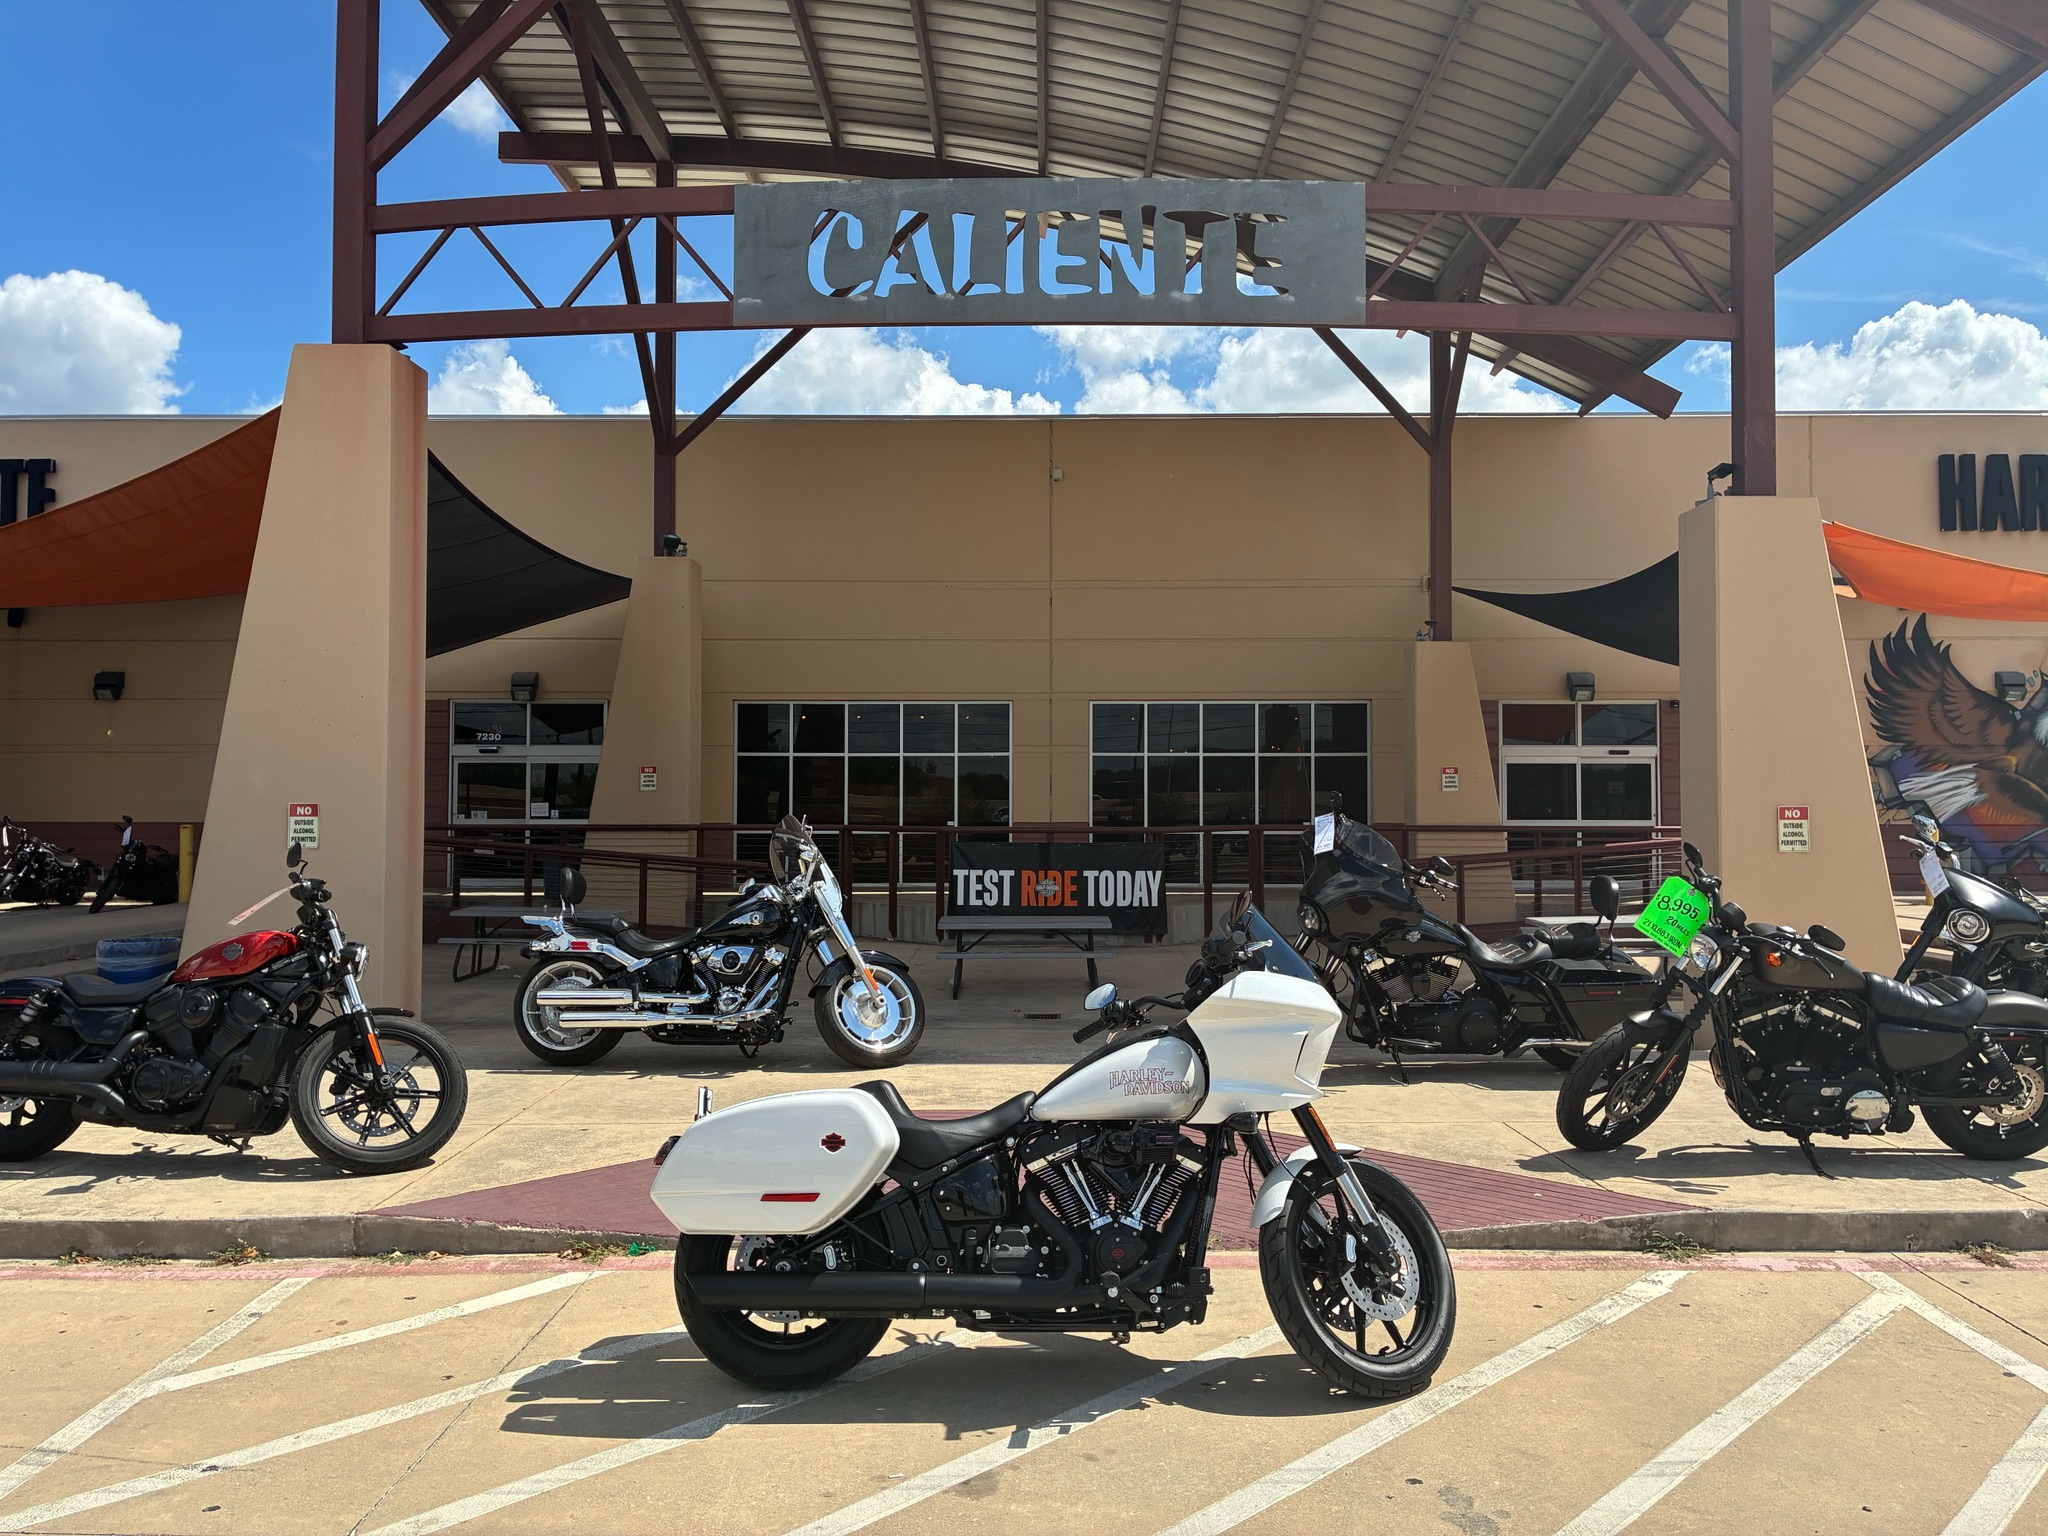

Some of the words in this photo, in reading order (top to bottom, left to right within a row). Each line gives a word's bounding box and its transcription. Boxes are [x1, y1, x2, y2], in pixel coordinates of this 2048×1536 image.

[807, 205, 1289, 297] CALIENTE
[1938, 454, 2048, 532] HAR
[476, 733, 501, 741] 7230
[296, 806, 312, 815] NO
[1784, 809, 1800, 818] NO
[953, 869, 1015, 906] TEST
[1020, 869, 1078, 907] RIDE
[1083, 870, 1163, 907] TODAY
[1665, 916, 1678, 927] 20
[1668, 934, 1684, 949] IRON
[1124, 1080, 1190, 1096] DAVIDSON
